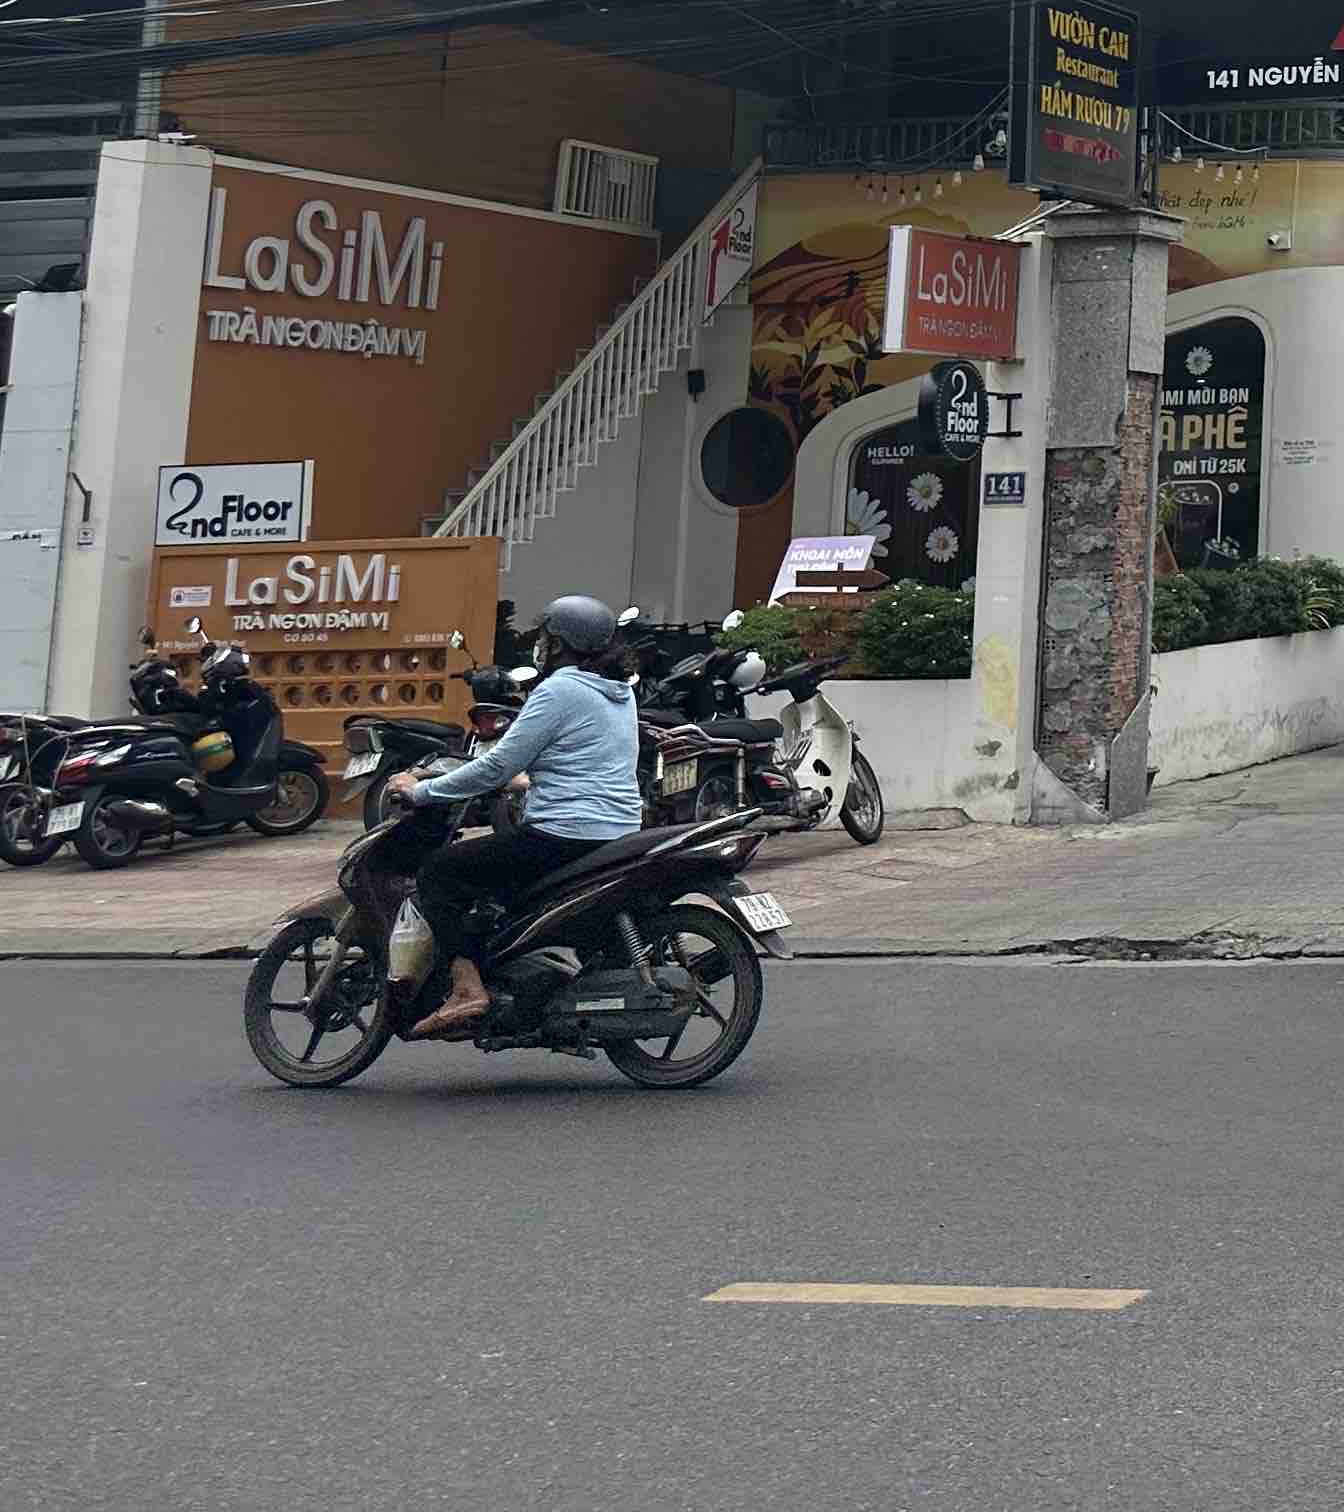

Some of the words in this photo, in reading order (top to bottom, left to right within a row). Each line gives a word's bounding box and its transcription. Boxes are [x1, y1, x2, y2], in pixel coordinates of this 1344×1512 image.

[1048, 7, 1094, 49] VƯỜN
[1099, 27, 1129, 61] CAU
[1056, 47, 1120, 89] Restaurant
[1207, 69, 1239, 89] 141
[1248, 57, 1340, 87] NGUYỄN
[1115, 105, 1131, 135] 79
[204, 186, 445, 311] LaSiMi
[916, 243, 1008, 312] LaSiMi
[207, 306, 260, 344] TRÀ
[262, 315, 342, 352] NGON
[947, 410, 979, 434] Floor
[1183, 406, 1248, 450] PHÊ
[868, 445, 915, 459] HELLO!
[1219, 458, 1247, 473] 25K
[166, 471, 228, 539] 2nd
[222, 494, 293, 523] Floor
[989, 475, 1021, 495] 141
[224, 553, 400, 607] LaSiMi
[233, 610, 265, 632] TRÀ
[269, 610, 324, 631] NGON
[326, 607, 368, 633] ĐẬM
[371, 610, 391, 632] VỊ
